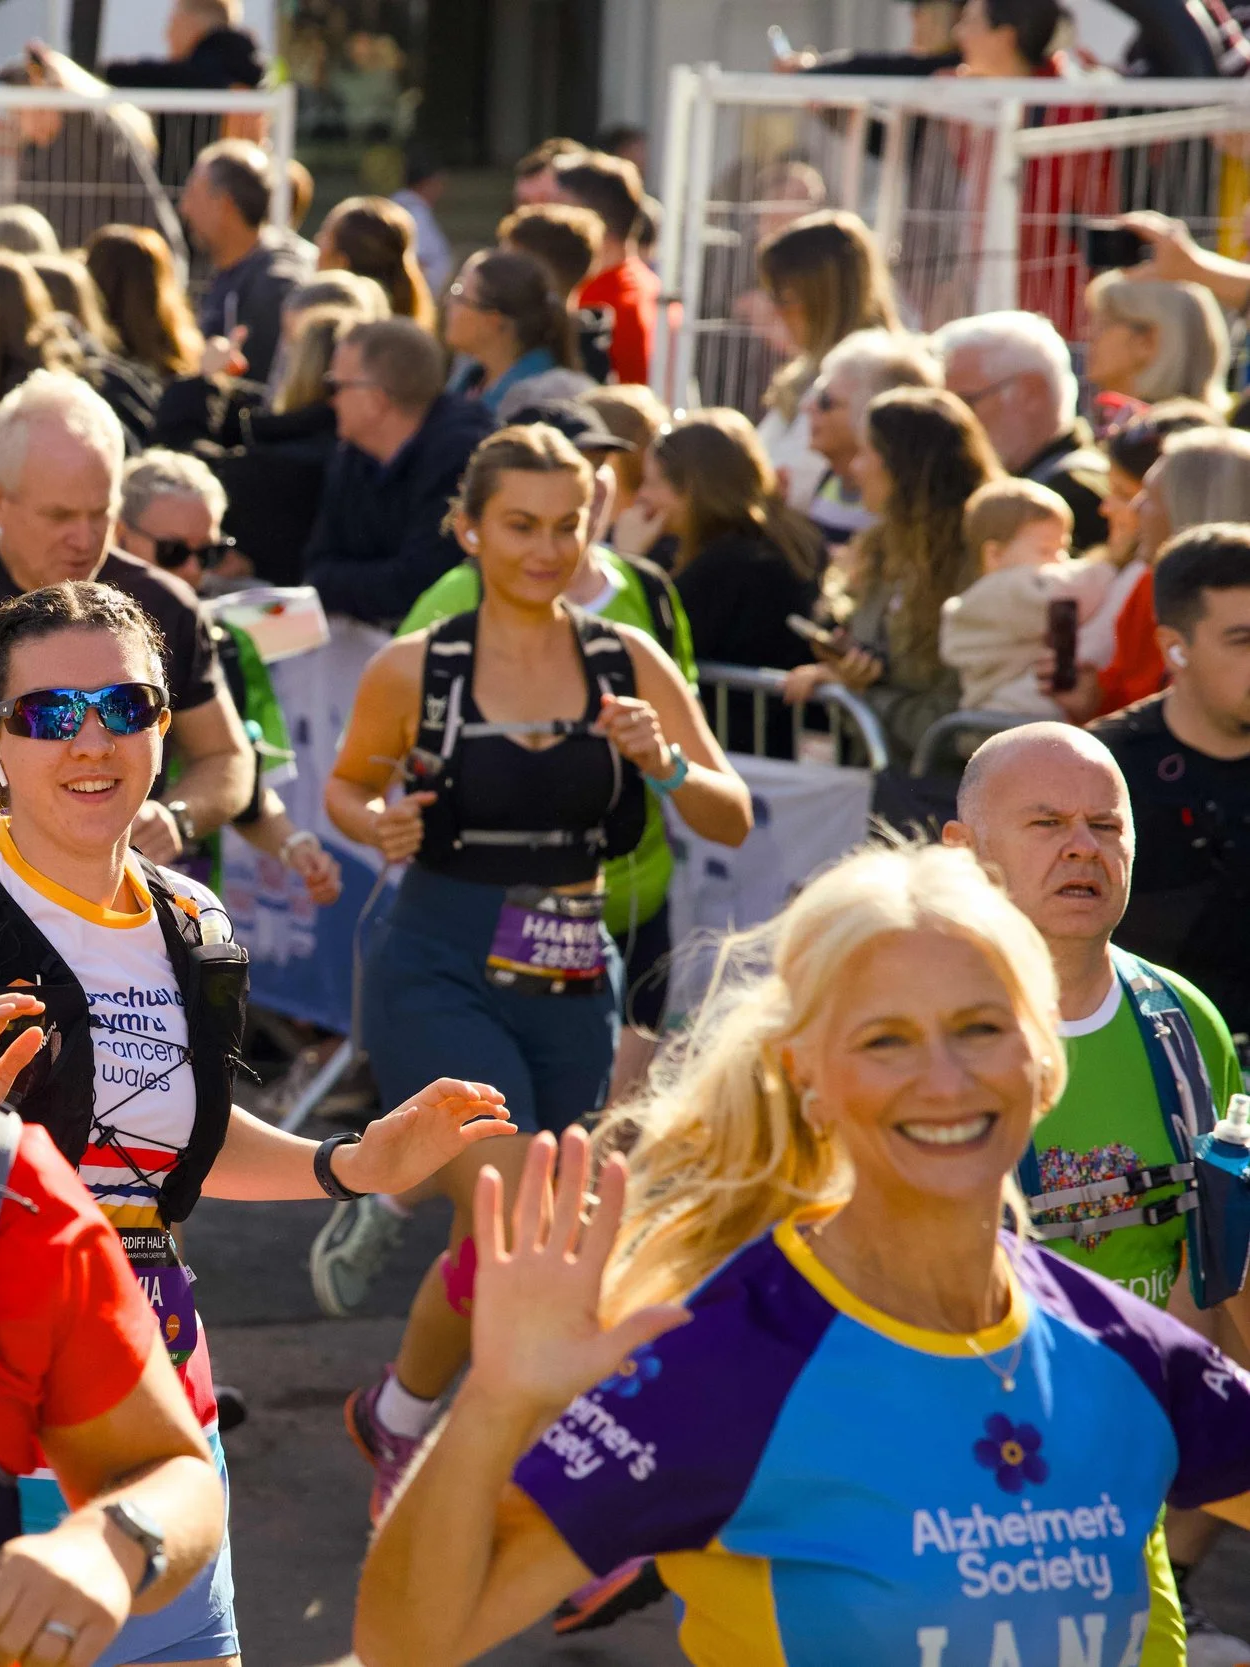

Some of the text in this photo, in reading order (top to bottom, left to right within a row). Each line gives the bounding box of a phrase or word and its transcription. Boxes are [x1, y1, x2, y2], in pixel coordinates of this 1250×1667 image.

[102, 1063, 170, 1092] wales
[147, 1236, 166, 1249] HALF
[912, 1491, 1127, 1557] Alzheimer's
[956, 1544, 1113, 1600] Society
